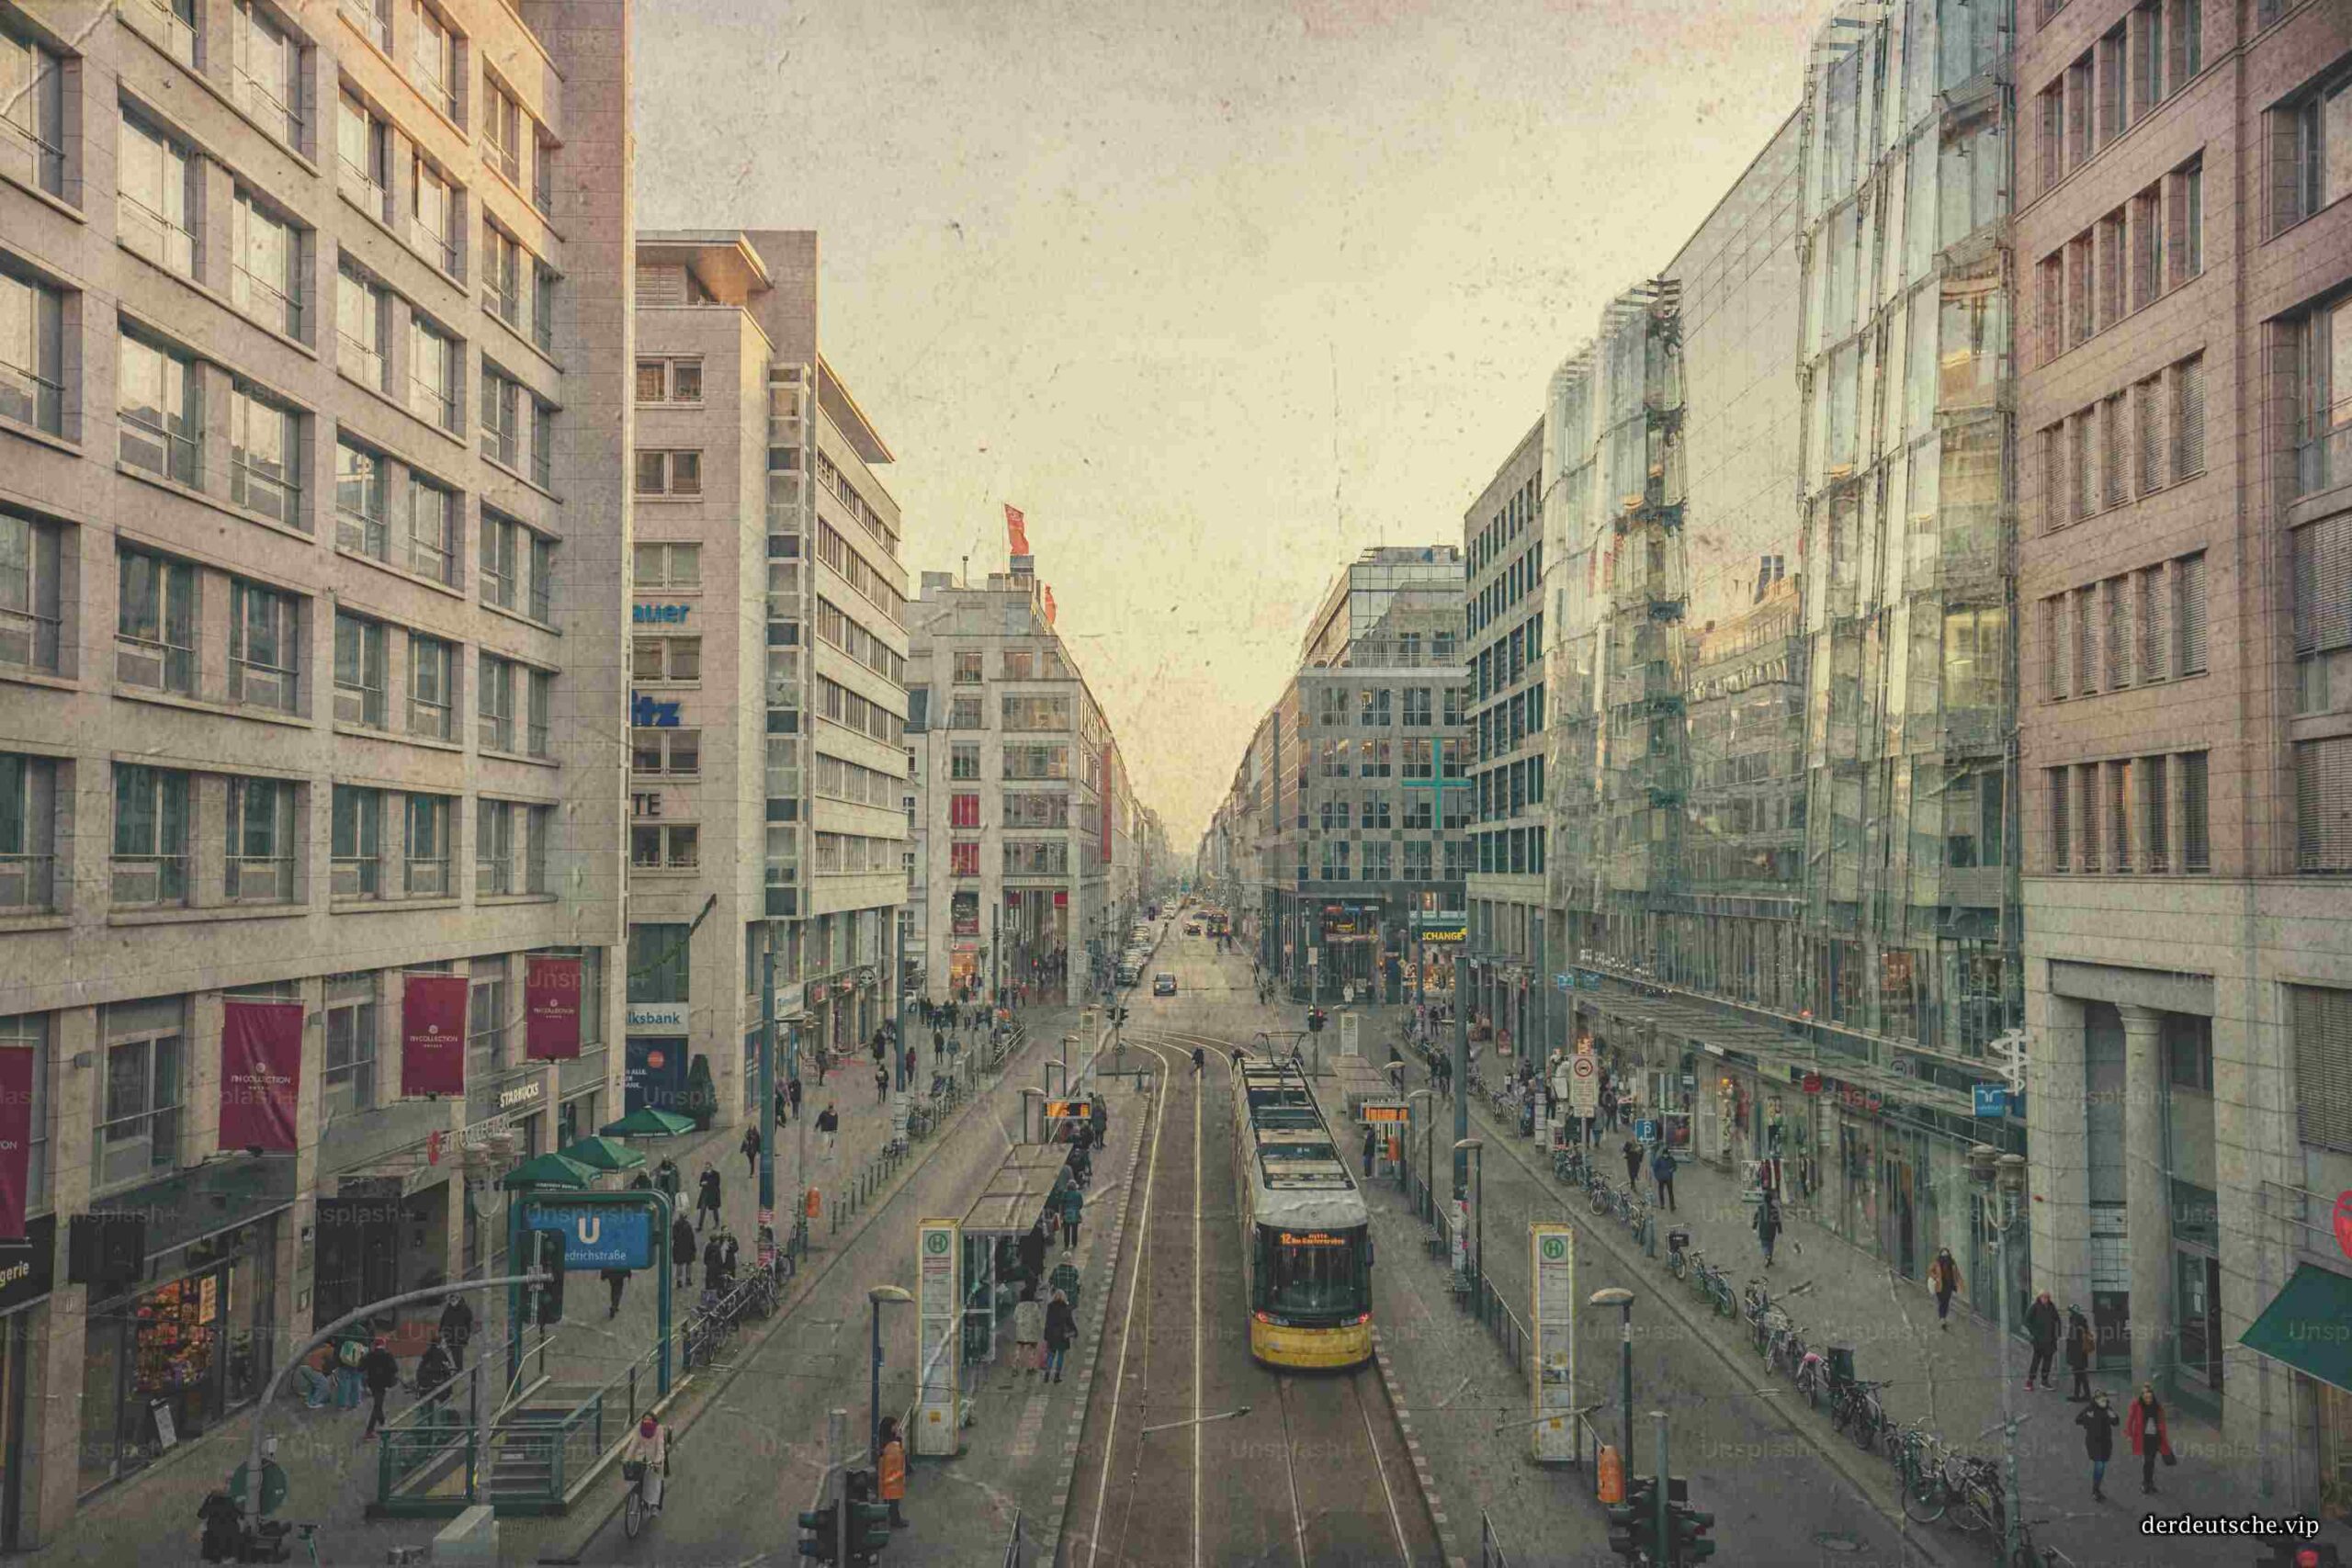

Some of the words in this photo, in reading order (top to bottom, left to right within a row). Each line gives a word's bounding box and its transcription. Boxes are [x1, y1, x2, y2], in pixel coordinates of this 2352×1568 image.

[500, 1082, 539, 1108] STARBUCKS
[578, 1217, 600, 1244] U
[1281, 1233, 1292, 1245] 12
